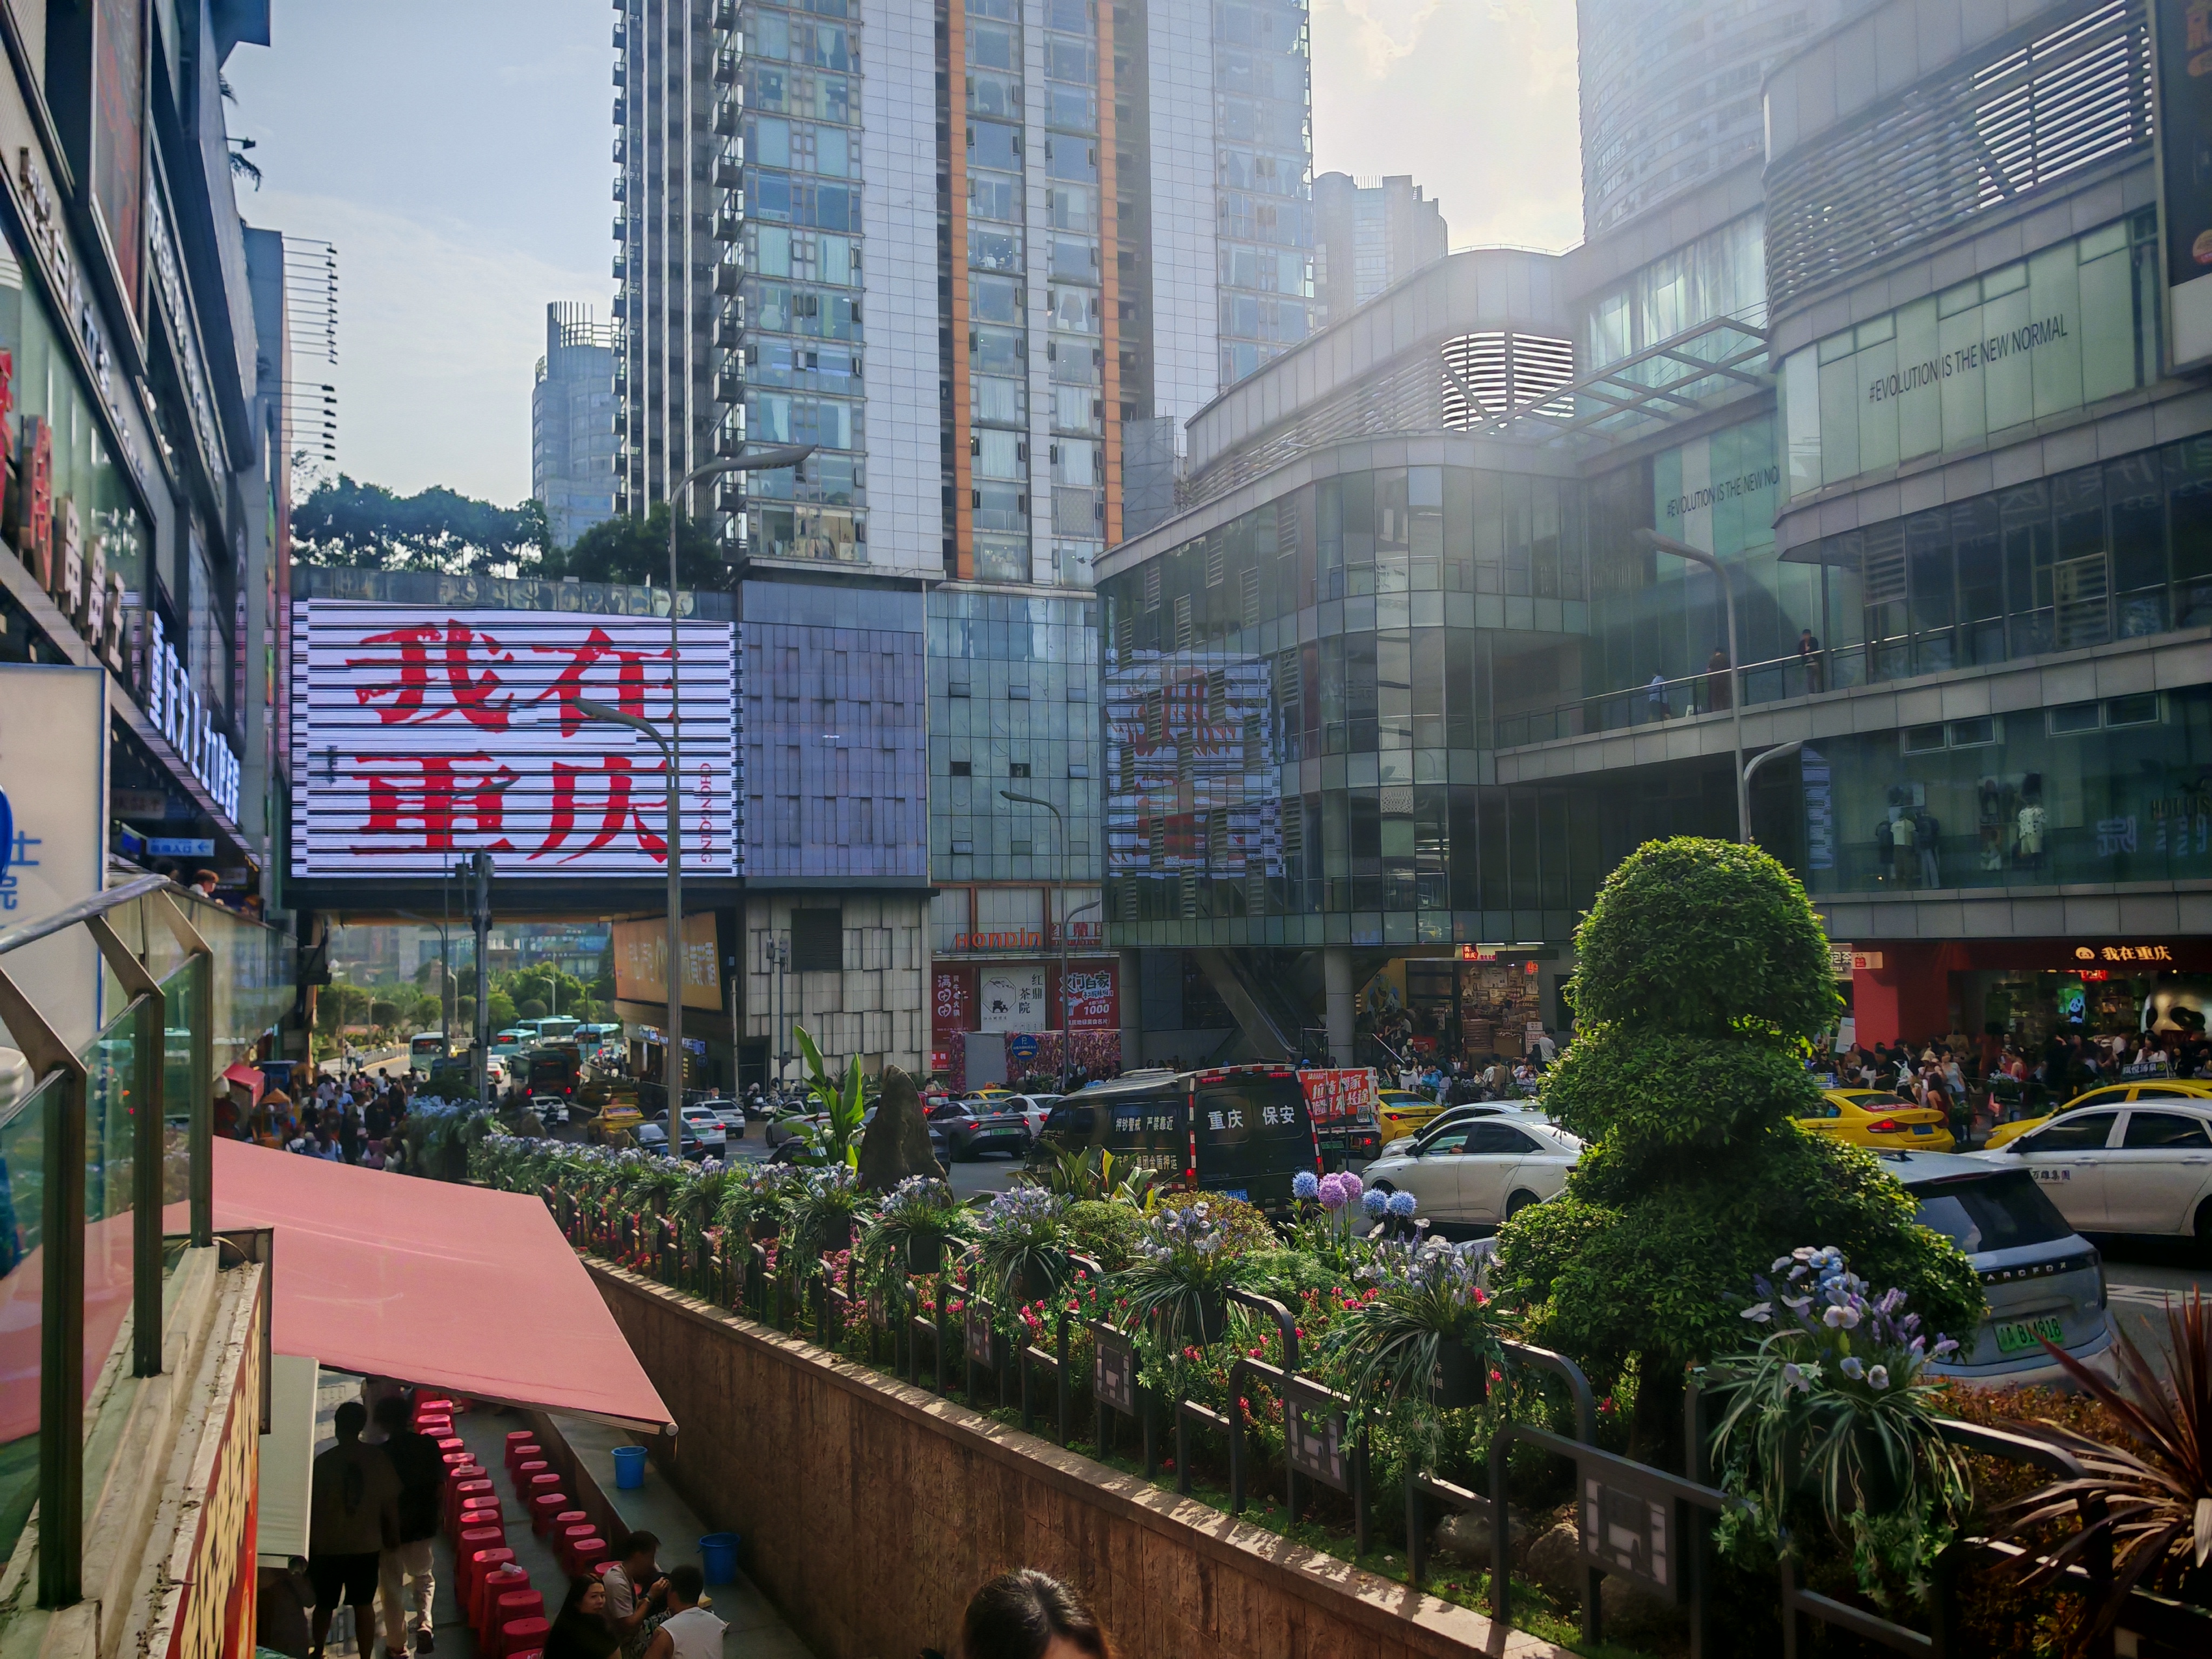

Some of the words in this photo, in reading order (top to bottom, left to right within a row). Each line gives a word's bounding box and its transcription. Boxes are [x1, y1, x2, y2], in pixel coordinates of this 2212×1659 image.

[1869, 360, 1939, 403] #EVOLUTION
[1941, 354, 1952, 379] IS
[1954, 345, 1977, 374] THE
[1980, 333, 2009, 365] NEW
[2012, 313, 2068, 354] NORMAL
[1717, 483, 1724, 502] IS
[1725, 477, 1741, 498] THE
[1744, 471, 1762, 494] NEW
[1764, 464, 1781, 487] NO
[345, 618, 681, 738] 我在
[350, 750, 673, 864] 重庆
[2101, 945, 2173, 961] 我在重庆
[1115, 1117, 1141, 1132] 押钞警戒
[1146, 1116, 1174, 1131] 严禁靠近
[1207, 1109, 1244, 1130] 重庆
[1262, 1105, 1295, 1125] 保安
